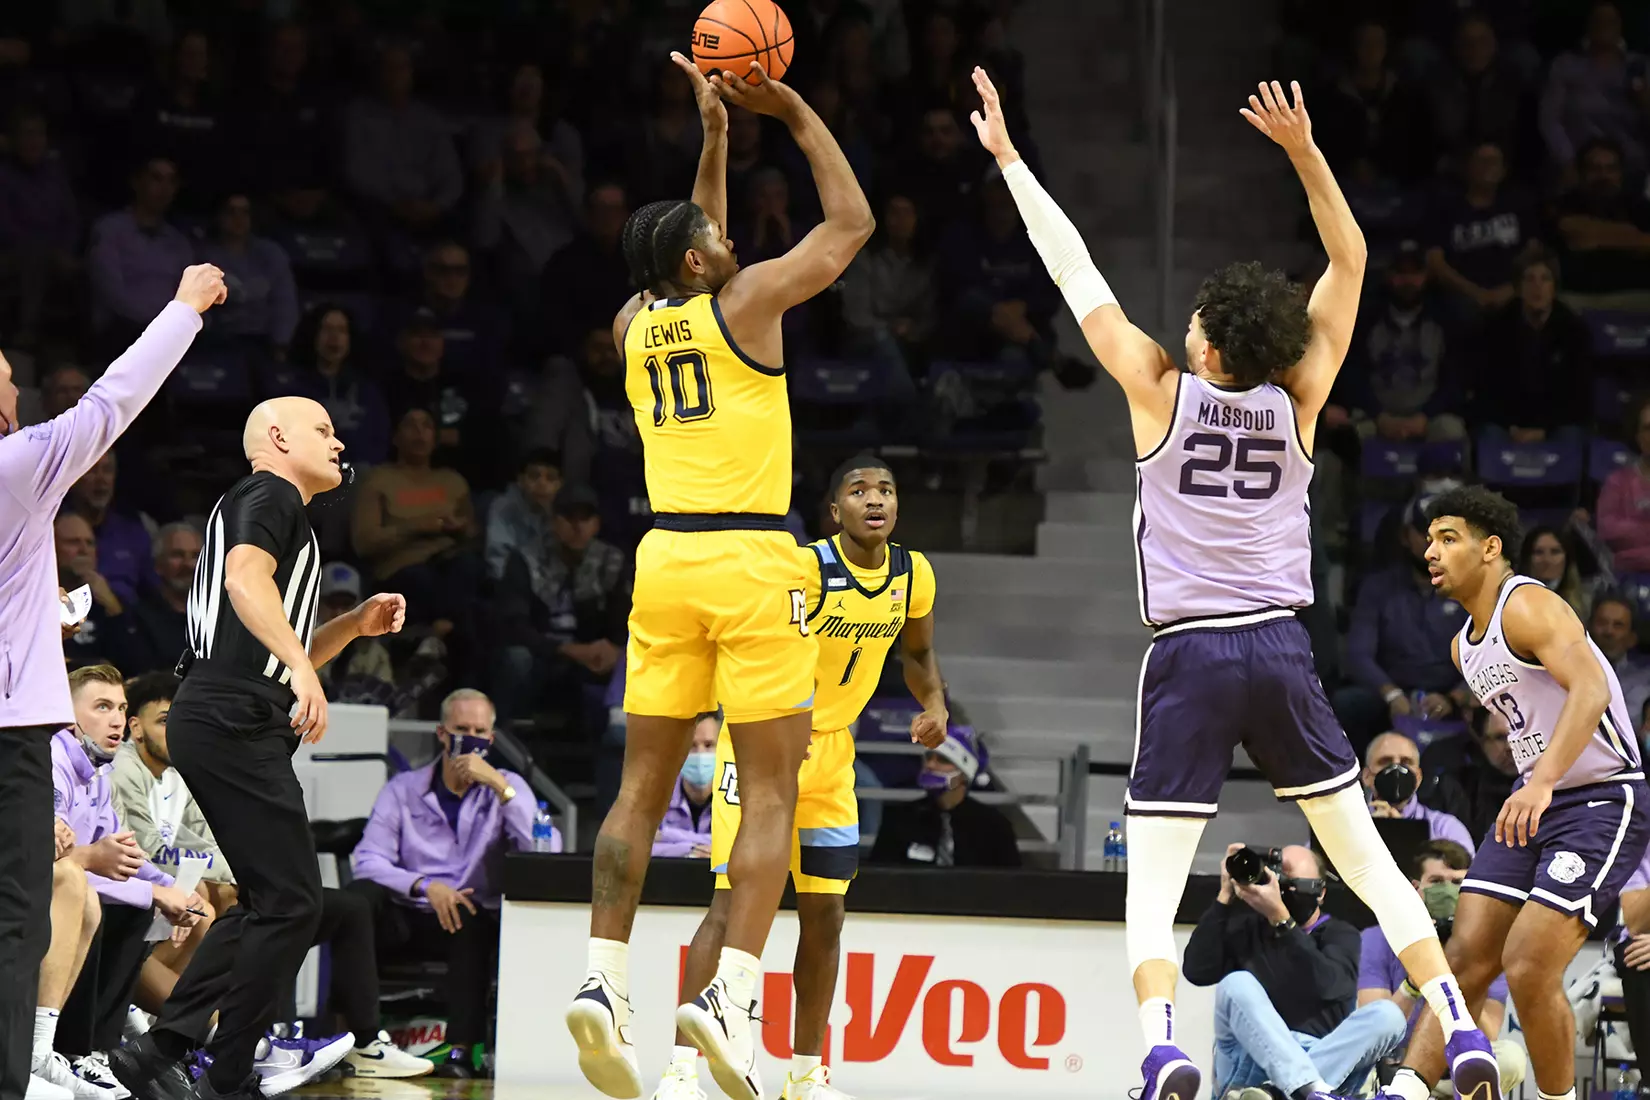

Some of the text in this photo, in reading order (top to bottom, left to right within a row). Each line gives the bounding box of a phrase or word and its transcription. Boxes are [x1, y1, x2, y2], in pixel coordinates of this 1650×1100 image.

[644, 319, 692, 348] LEWIS
[644, 348, 716, 427] 10
[1197, 401, 1275, 431] MASSOUD
[1179, 432, 1287, 499] 25
[815, 615, 902, 644] Marquette
[839, 647, 862, 687] 1
[1470, 663, 1519, 699] KANSAS
[1491, 691, 1526, 731] 13
